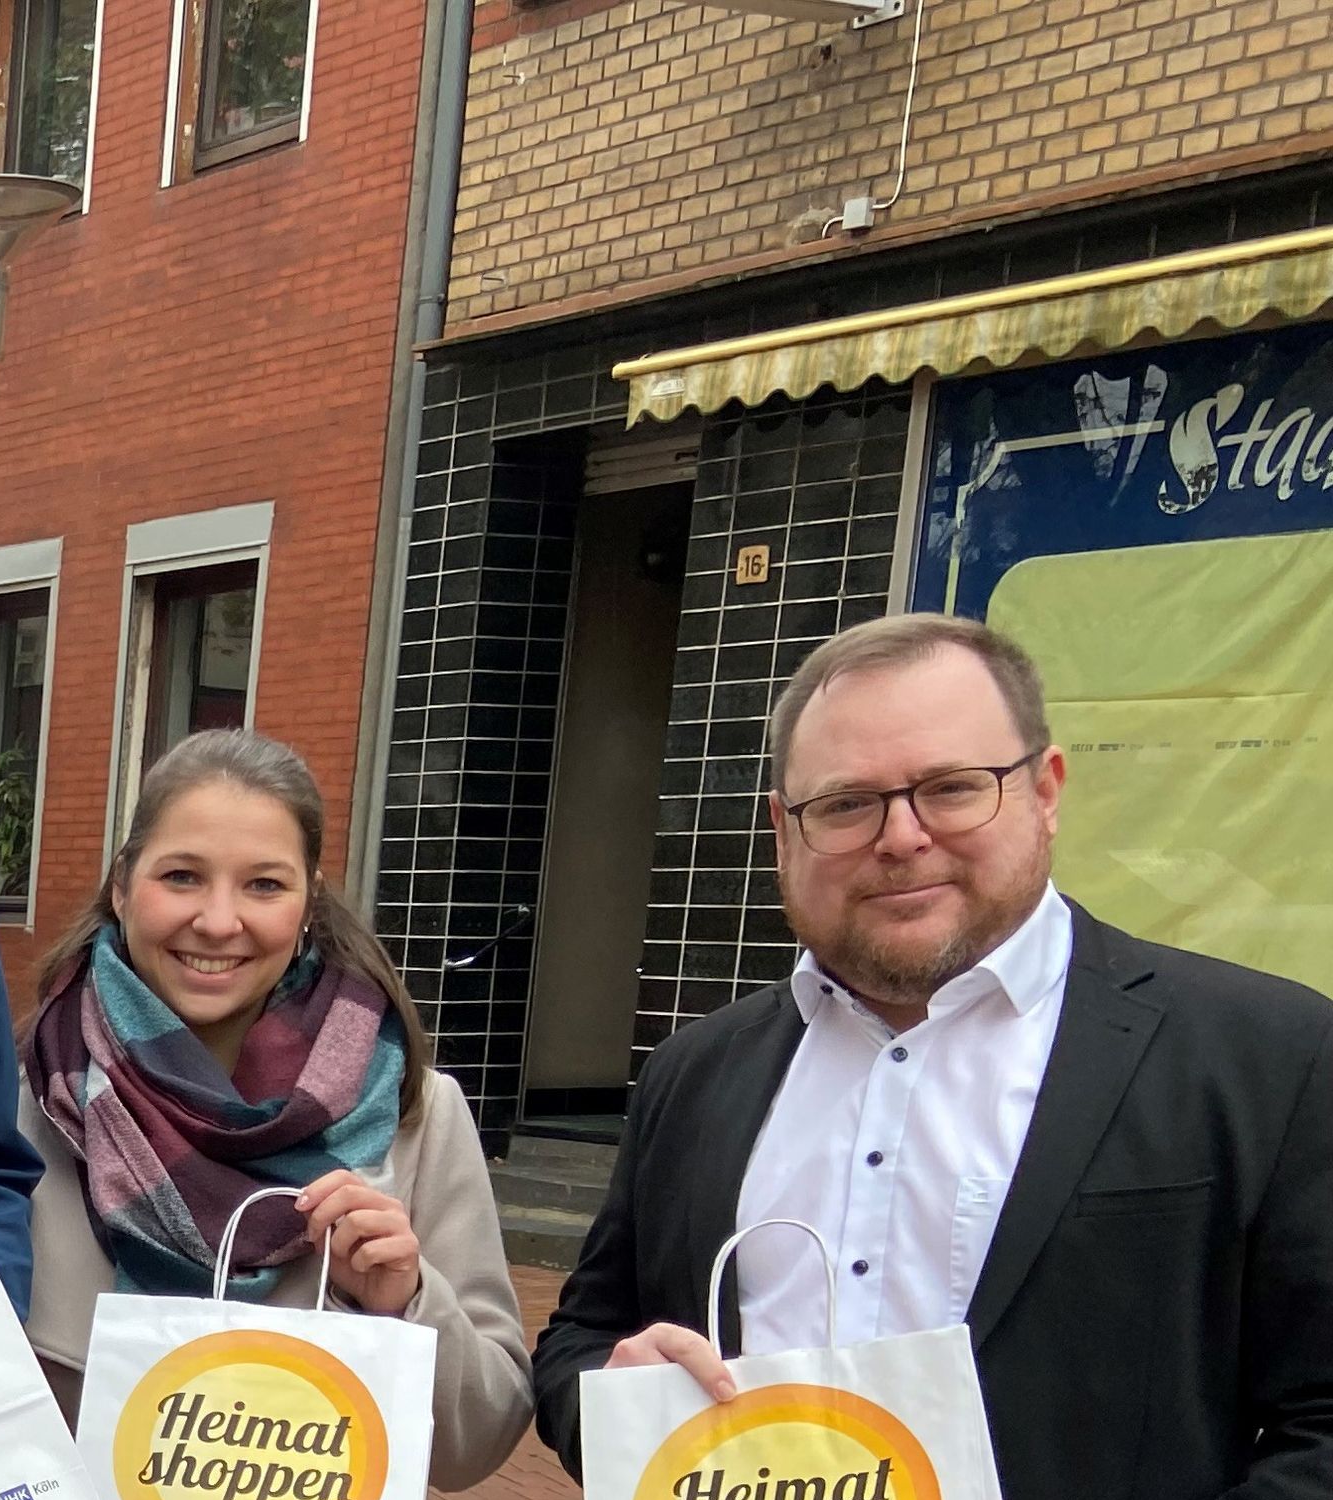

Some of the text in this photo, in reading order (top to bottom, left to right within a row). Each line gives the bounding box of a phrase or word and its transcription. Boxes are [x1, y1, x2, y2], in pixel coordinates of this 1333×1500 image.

[744, 554, 763, 578] 16
[157, 1391, 353, 1457] Heimat
[32, 1479, 60, 1495] Köln
